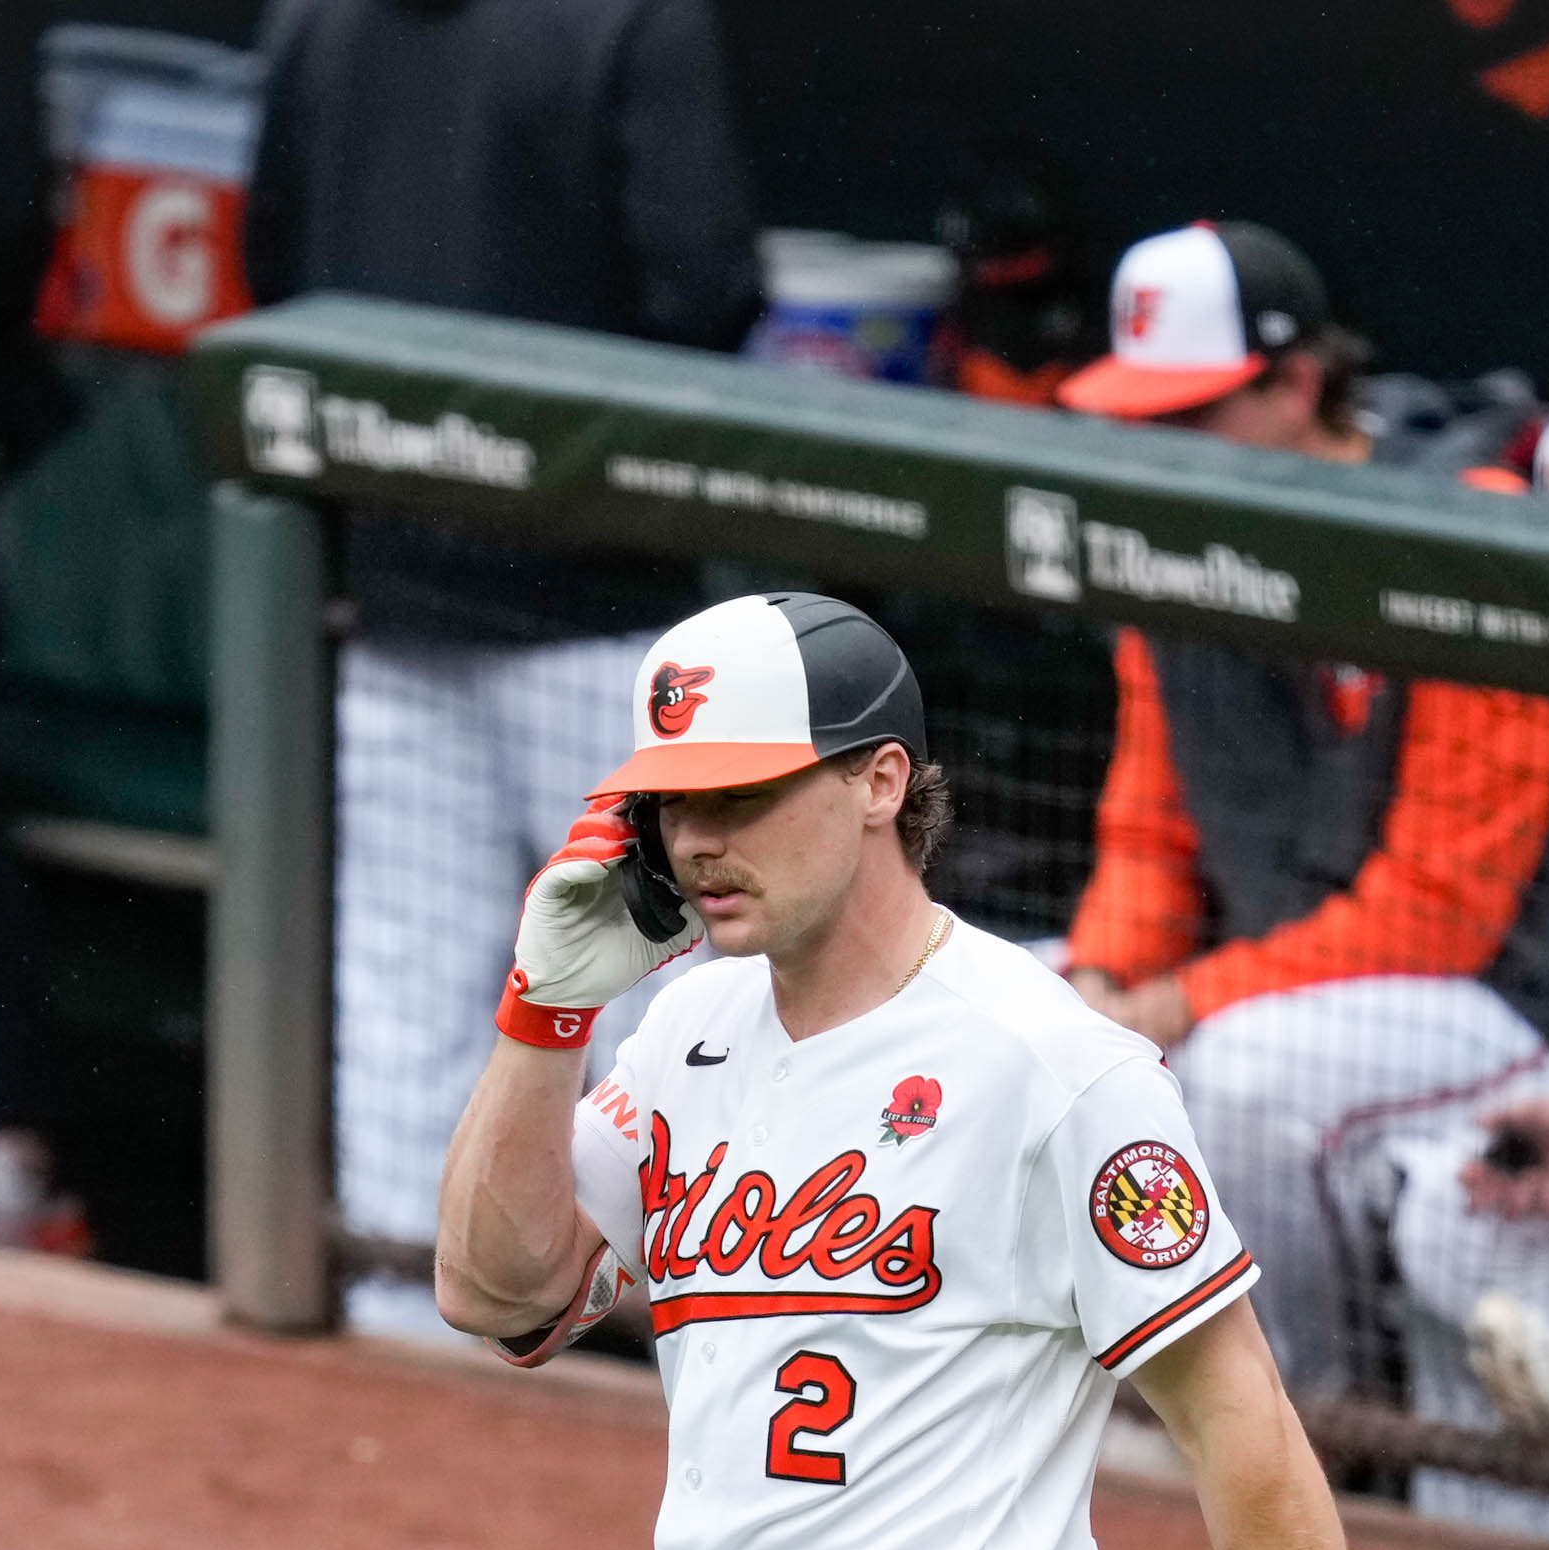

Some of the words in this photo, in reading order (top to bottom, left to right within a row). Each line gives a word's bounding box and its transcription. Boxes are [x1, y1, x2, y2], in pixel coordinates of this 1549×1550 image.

[124, 183, 216, 322] G
[1096, 1145, 1176, 1217] BALTIMORE
[1142, 1210, 1205, 1263] ORIOLES
[766, 1349, 857, 1486] 2
